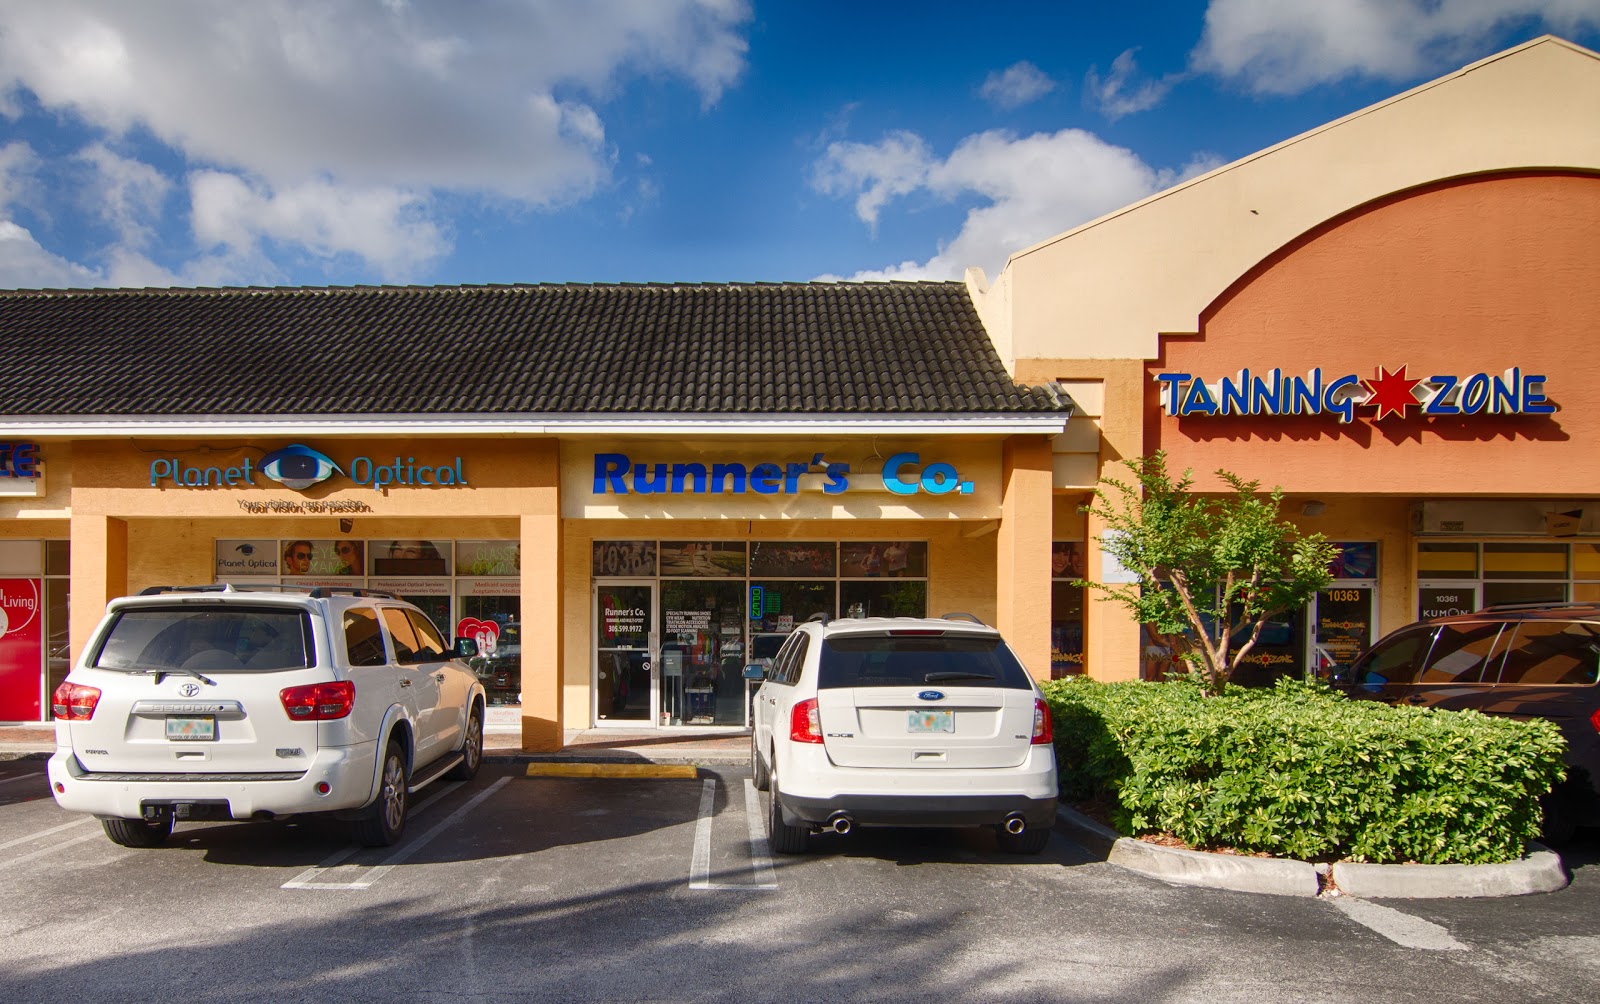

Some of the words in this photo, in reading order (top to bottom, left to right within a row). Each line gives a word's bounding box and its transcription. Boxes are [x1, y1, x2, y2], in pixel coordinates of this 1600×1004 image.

[1156, 367, 1359, 424] TANNING
[1425, 366, 1557, 415] ZONE
[150, 457, 256, 487] Planet
[351, 456, 468, 492] Optical
[592, 452, 852, 496] Runner's
[882, 451, 975, 496] Co.
[218, 559, 245, 568] Planet
[248, 559, 278, 569] Optical
[596, 545, 657, 573] 10365
[3, 595, 34, 610] Living
[752, 588, 761, 617] OPEN
[1328, 590, 1360, 601] 10363
[1436, 595, 1458, 603] 10361
[605, 608, 634, 616] Runner's
[635, 608, 646, 616] Co.
[1423, 608, 1468, 617] KUMON
